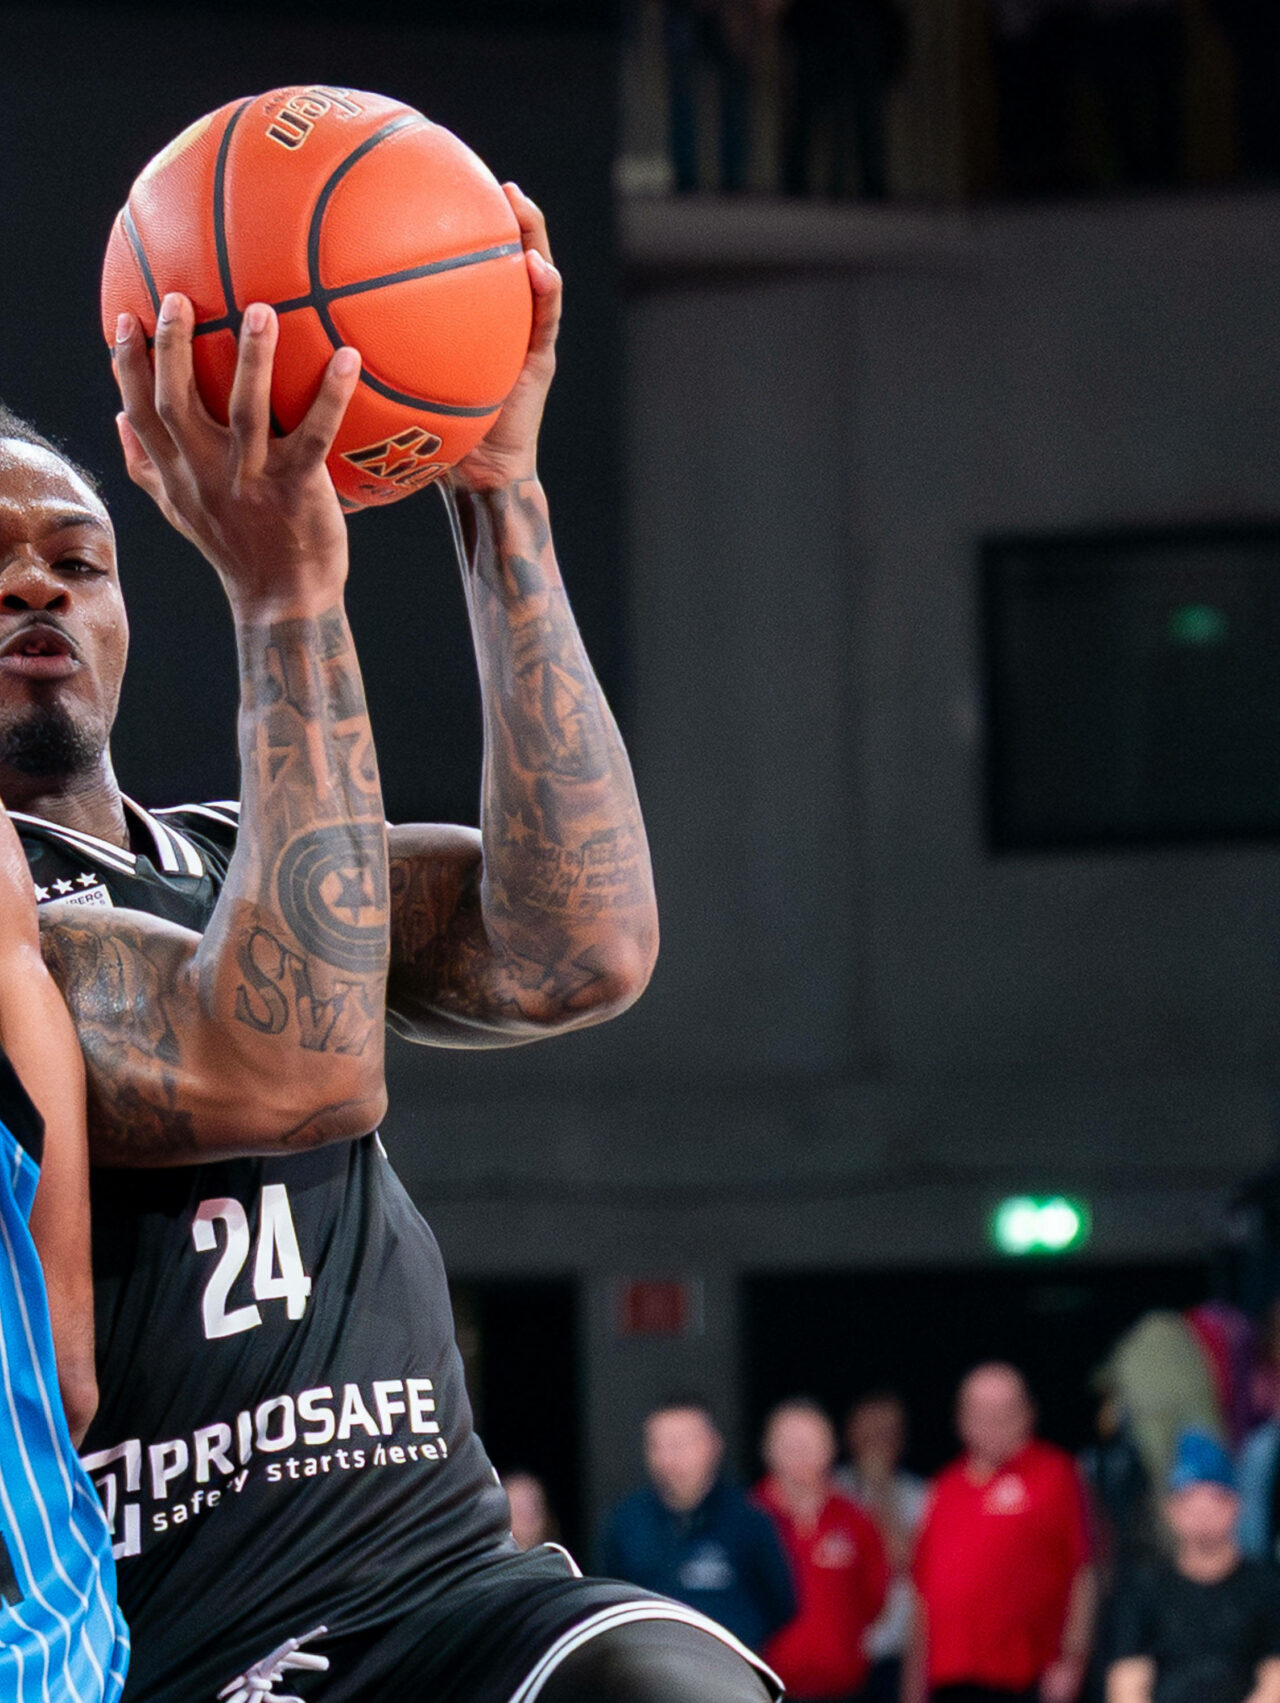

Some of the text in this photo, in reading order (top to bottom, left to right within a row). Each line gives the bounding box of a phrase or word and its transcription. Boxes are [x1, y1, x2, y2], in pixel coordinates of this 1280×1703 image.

[66, 890, 104, 905] BERG
[191, 1183, 312, 1340] 24
[148, 1378, 440, 1500] PRIOSAFE
[152, 1436, 449, 1532] safey starts here!
